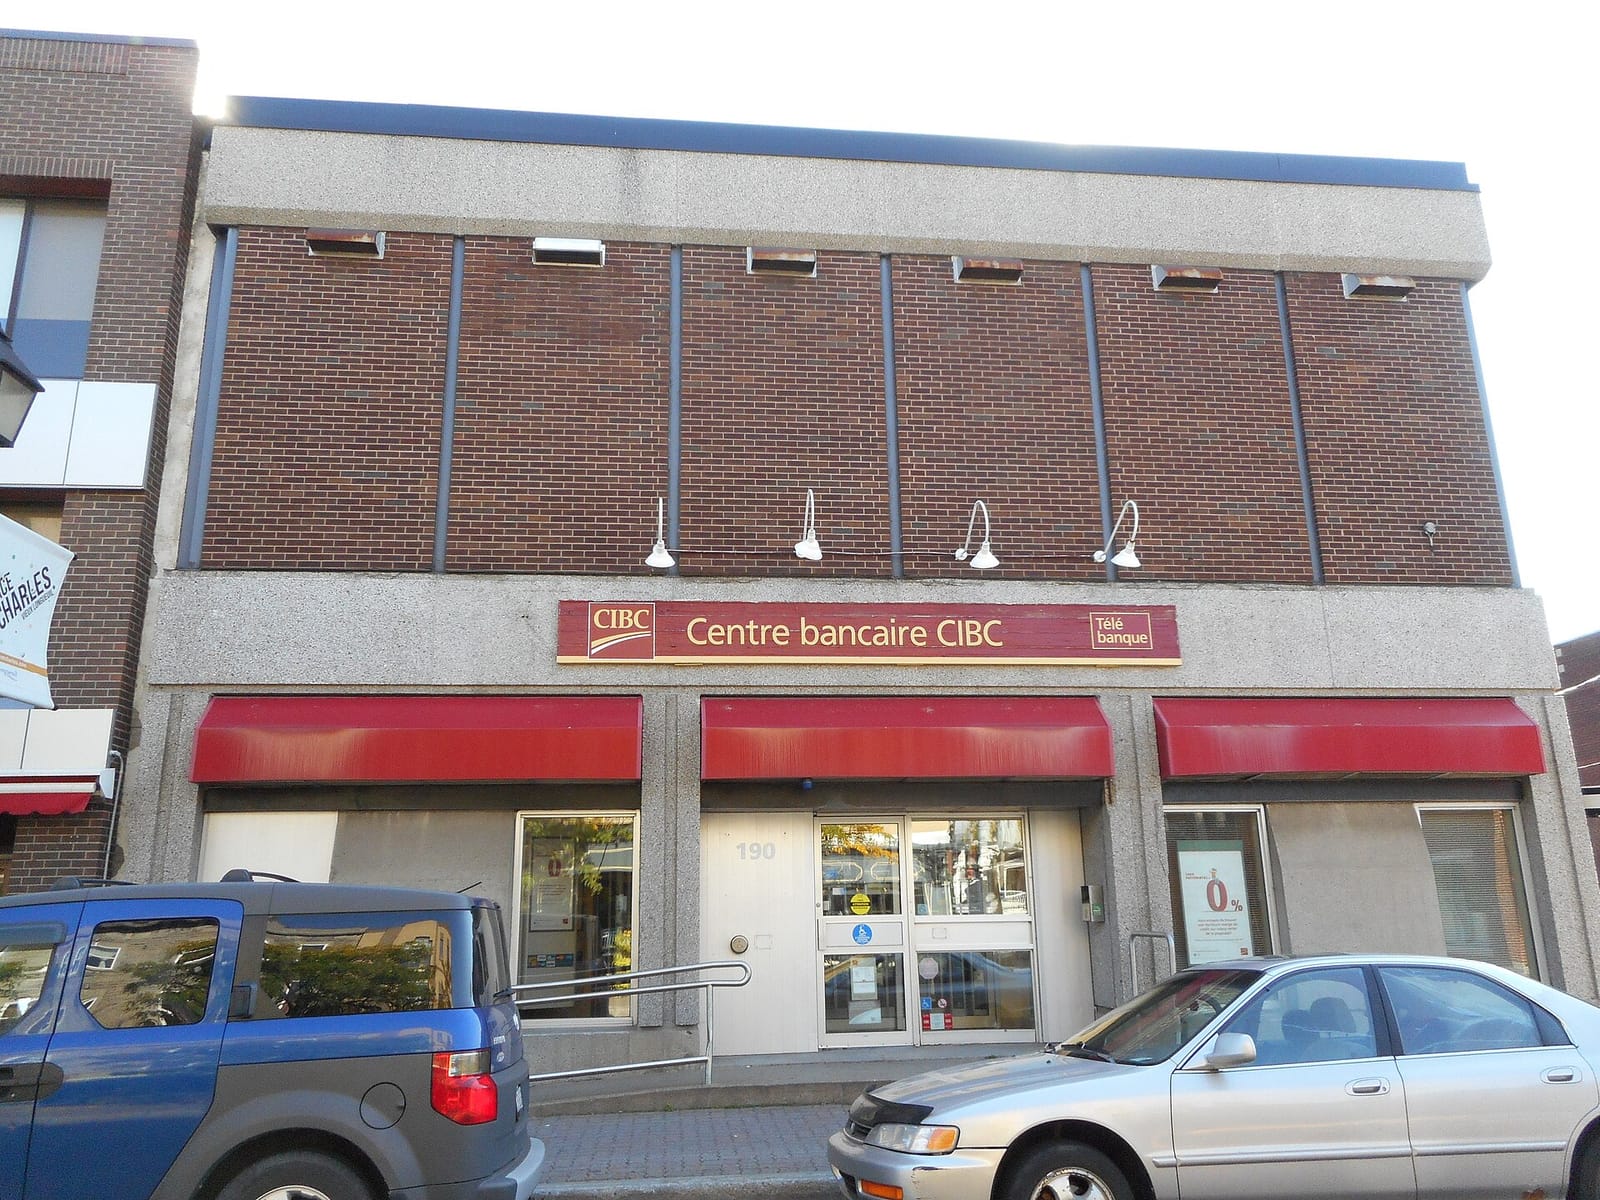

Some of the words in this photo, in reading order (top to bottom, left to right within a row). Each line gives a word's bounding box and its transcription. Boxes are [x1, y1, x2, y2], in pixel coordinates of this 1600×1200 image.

[0, 572, 13, 598] CE
[593, 608, 650, 630] CIBC
[1095, 616, 1124, 631] Télé
[687, 617, 790, 646] Centre
[800, 617, 927, 647] bancaire
[936, 619, 1004, 647] CIBC
[1097, 630, 1148, 646] banque
[736, 842, 776, 860] 190
